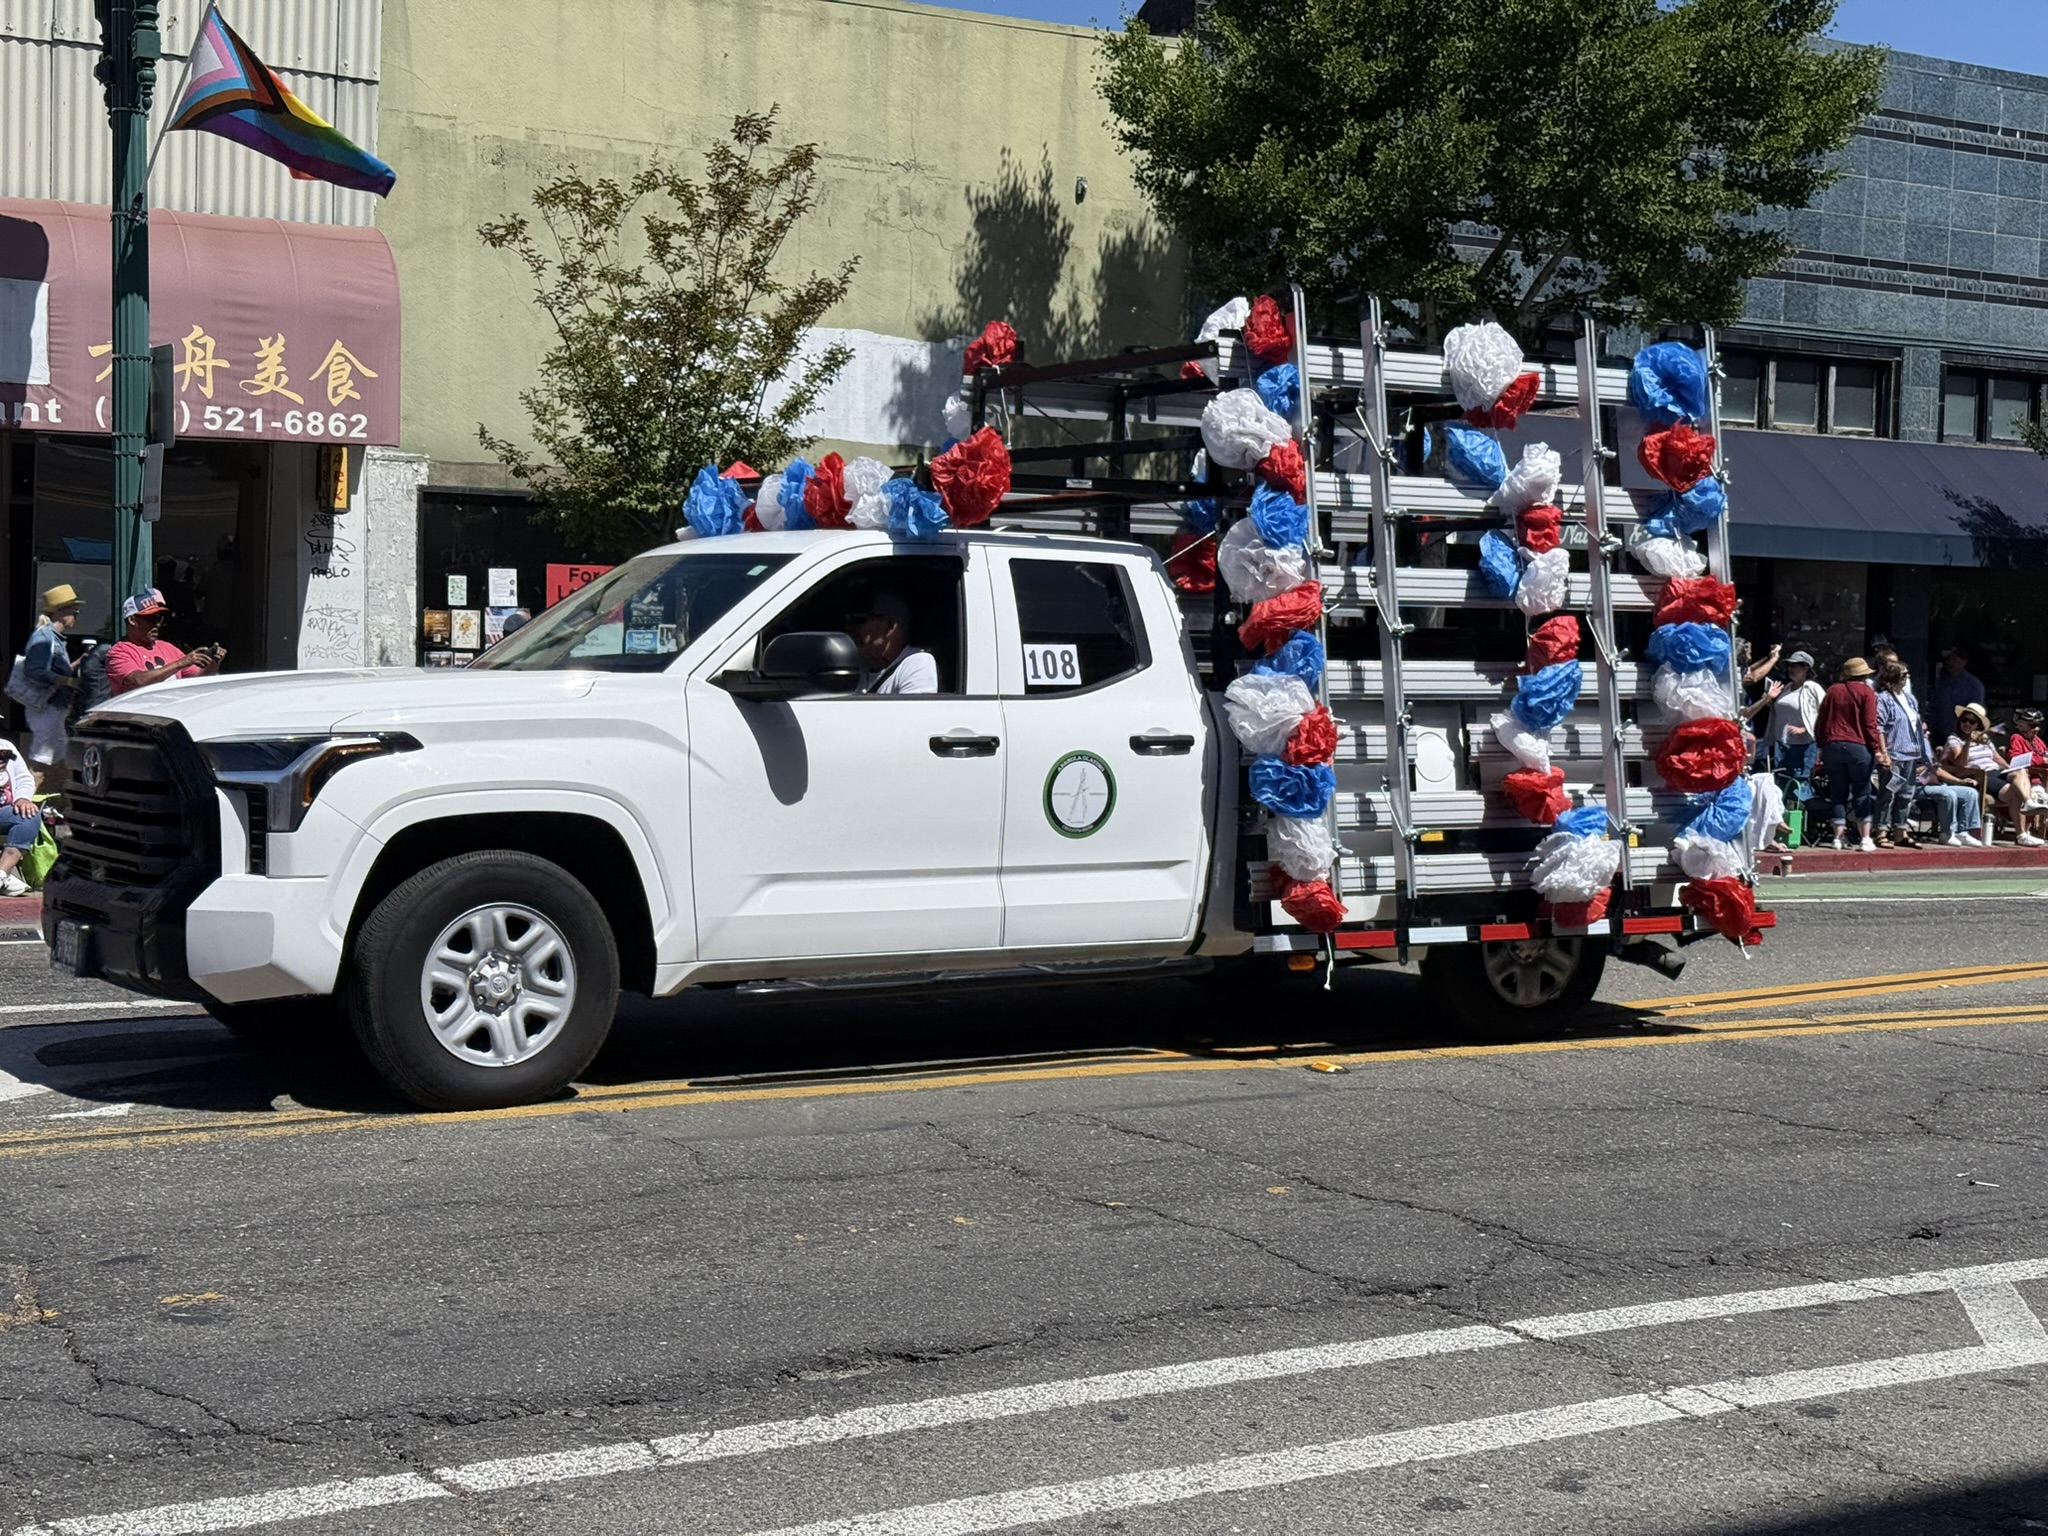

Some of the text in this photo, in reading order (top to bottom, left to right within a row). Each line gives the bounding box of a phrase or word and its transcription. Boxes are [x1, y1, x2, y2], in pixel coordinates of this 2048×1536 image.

[203, 405, 368, 438] 521-6862
[569, 567, 602, 582] For
[1028, 649, 1076, 680] 108
